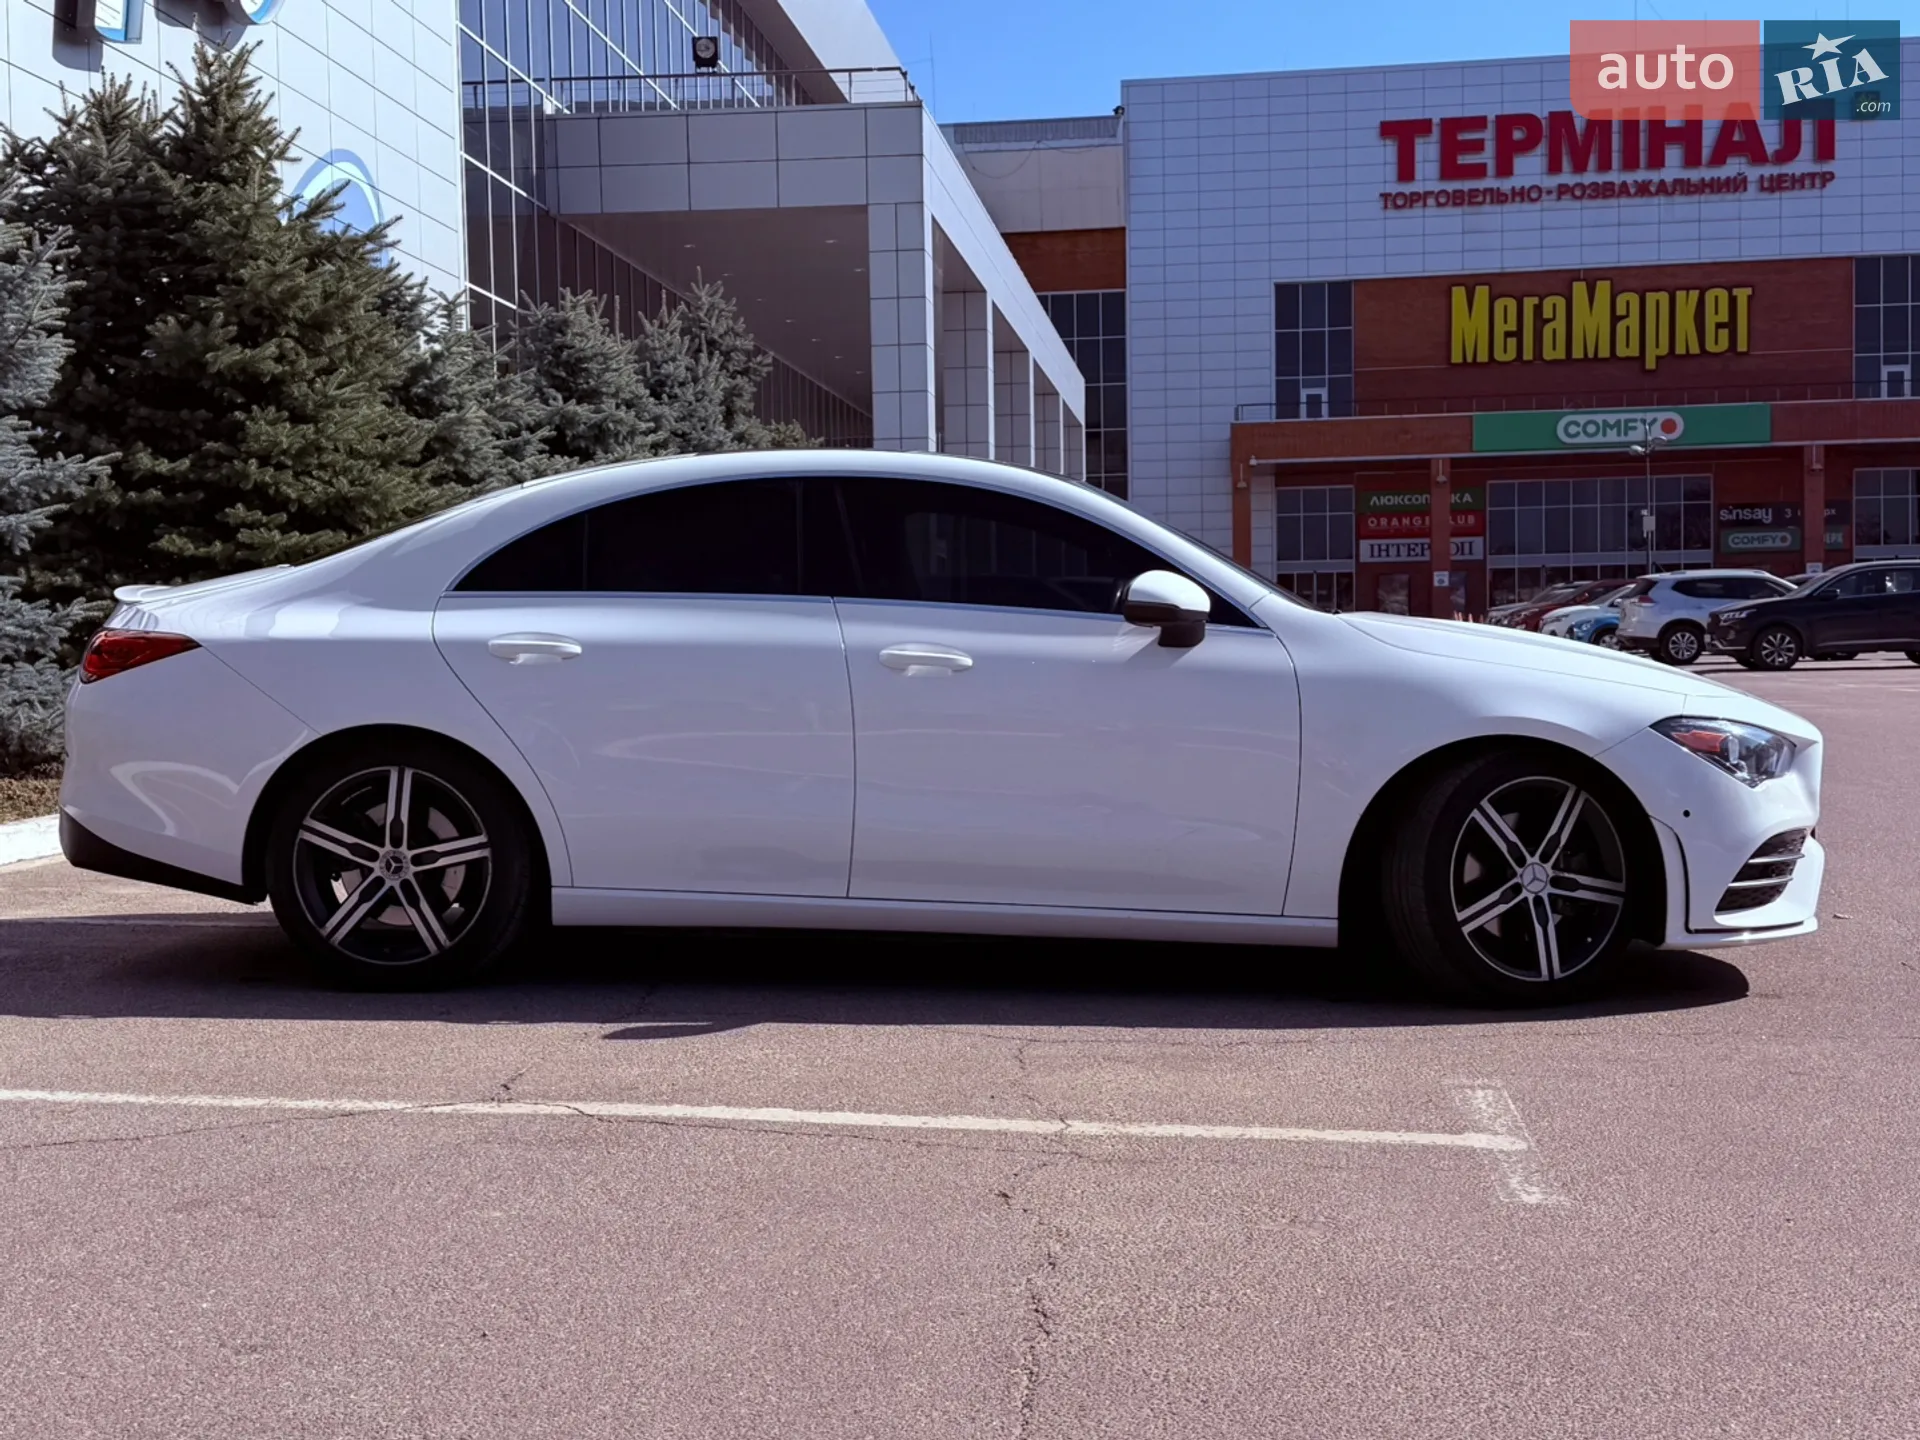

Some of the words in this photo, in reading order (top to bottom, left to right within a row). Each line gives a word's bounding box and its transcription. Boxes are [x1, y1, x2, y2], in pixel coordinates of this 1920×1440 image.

[1380, 97, 1836, 183] ТЕРМІНАЛ
[1758, 171, 1836, 195] ЦЕНТР
[1450, 279, 1753, 371] МегаМаркет
[1562, 416, 1658, 439] COMFY
[1370, 493, 1473, 506] ЛЮКСОПКА
[1448, 514, 1476, 525] LUB
[1719, 505, 1772, 524] sinsay
[1368, 540, 1475, 559] ІНТЕРОП
[1731, 535, 1778, 546] COMFY
